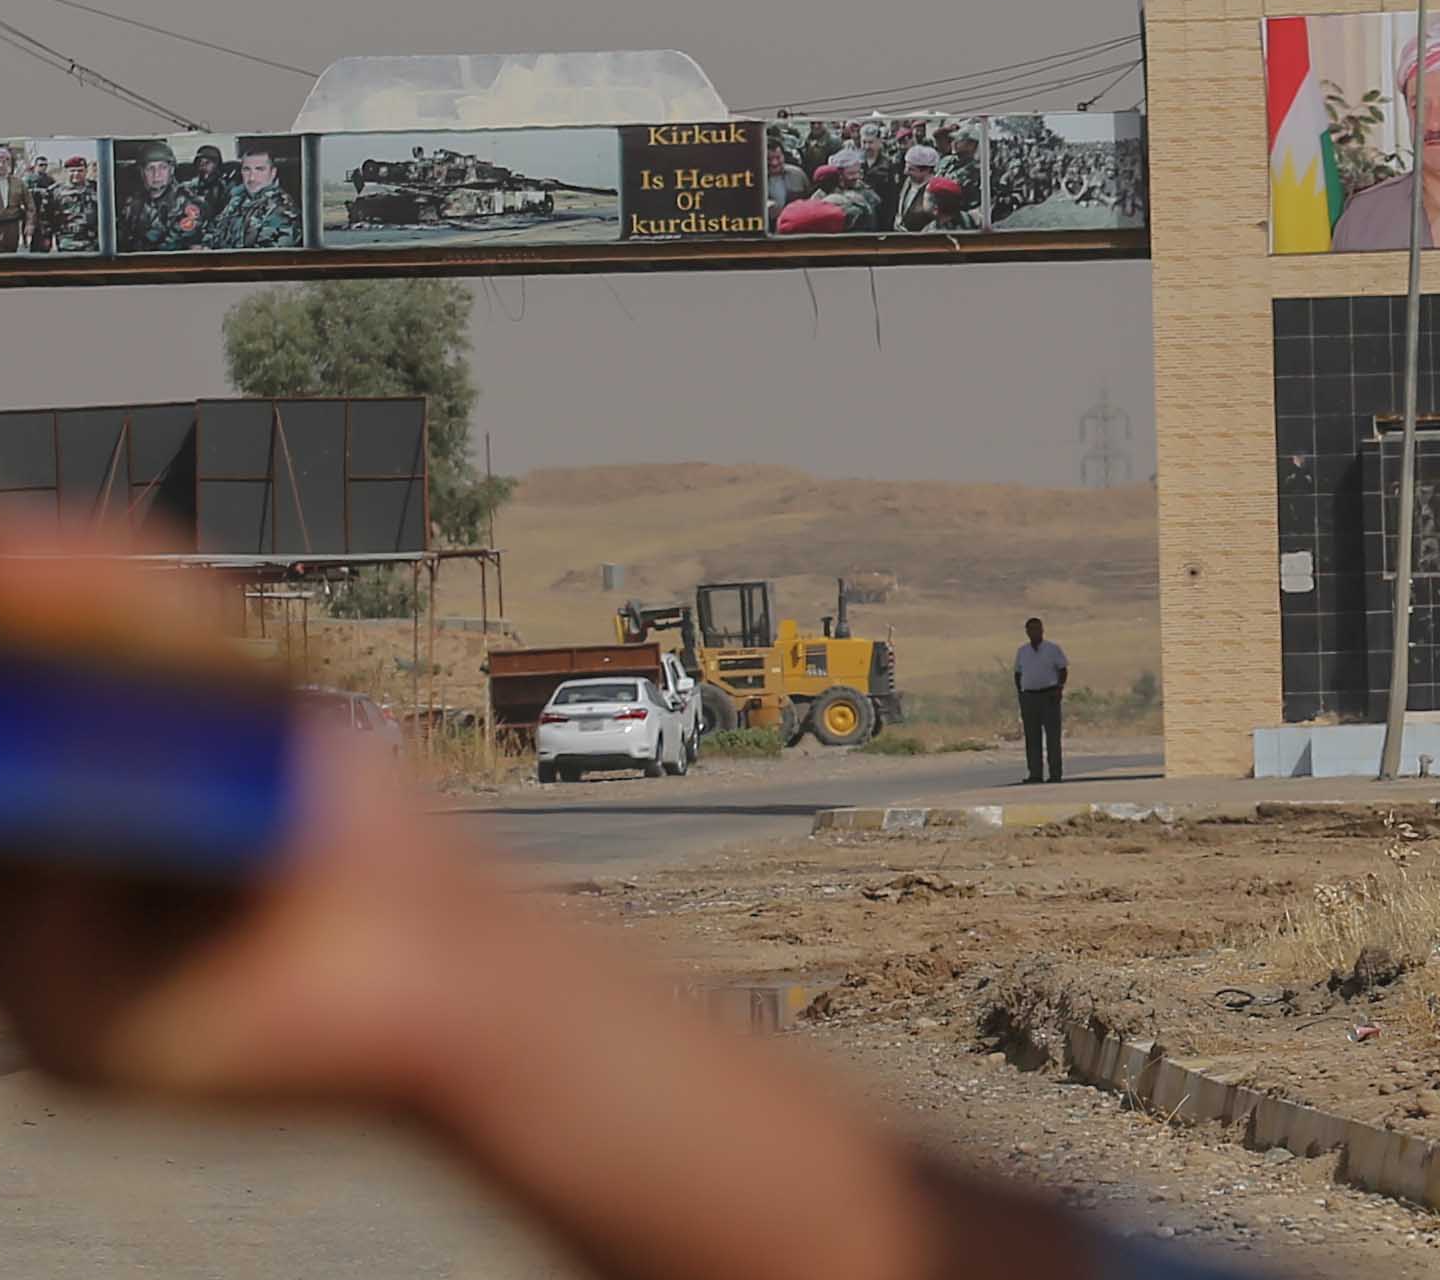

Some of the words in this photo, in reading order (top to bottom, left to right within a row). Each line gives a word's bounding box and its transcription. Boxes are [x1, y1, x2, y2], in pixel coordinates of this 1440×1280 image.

[647, 124, 747, 145] Kirkuk
[640, 170, 664, 190] Is
[674, 169, 754, 189] Heart
[676, 191, 704, 211] Of
[631, 213, 764, 234] kurdistan
